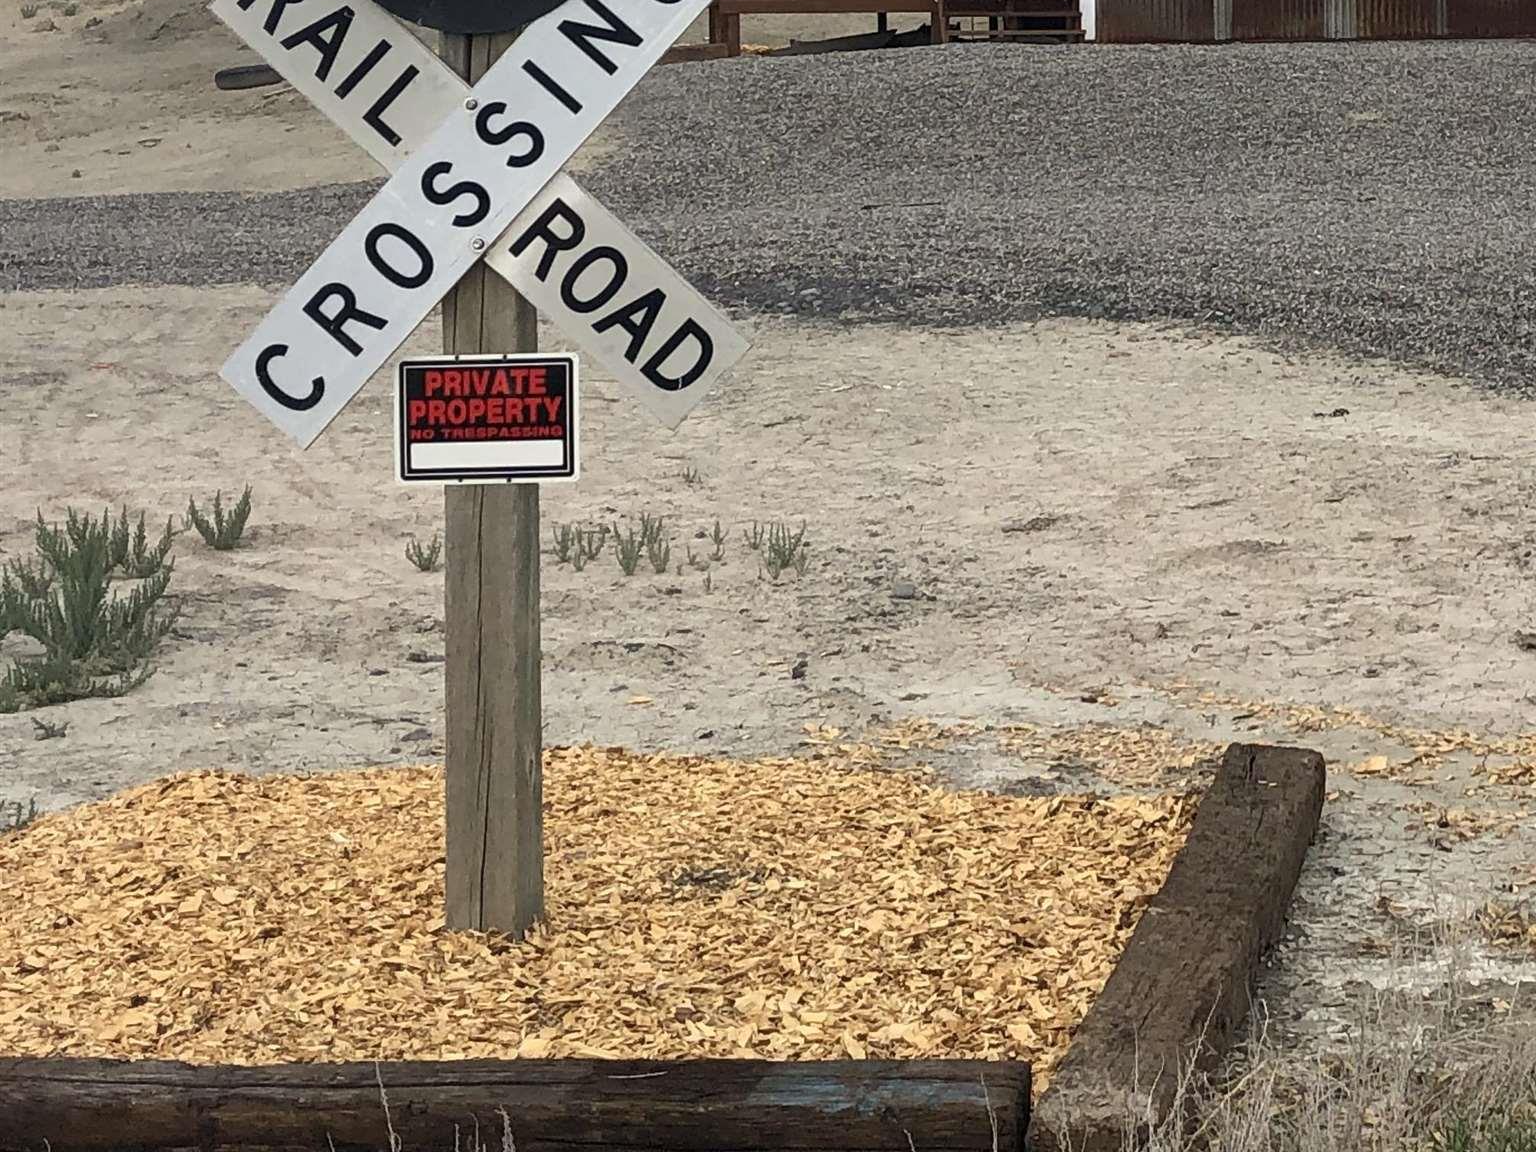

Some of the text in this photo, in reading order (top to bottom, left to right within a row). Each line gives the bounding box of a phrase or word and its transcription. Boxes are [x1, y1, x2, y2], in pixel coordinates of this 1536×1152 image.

[508, 196, 714, 392] ROAD
[424, 368, 547, 397] PRIVATE
[409, 396, 563, 425] PROPERTY
[410, 425, 564, 440] NO TRESPASSING
